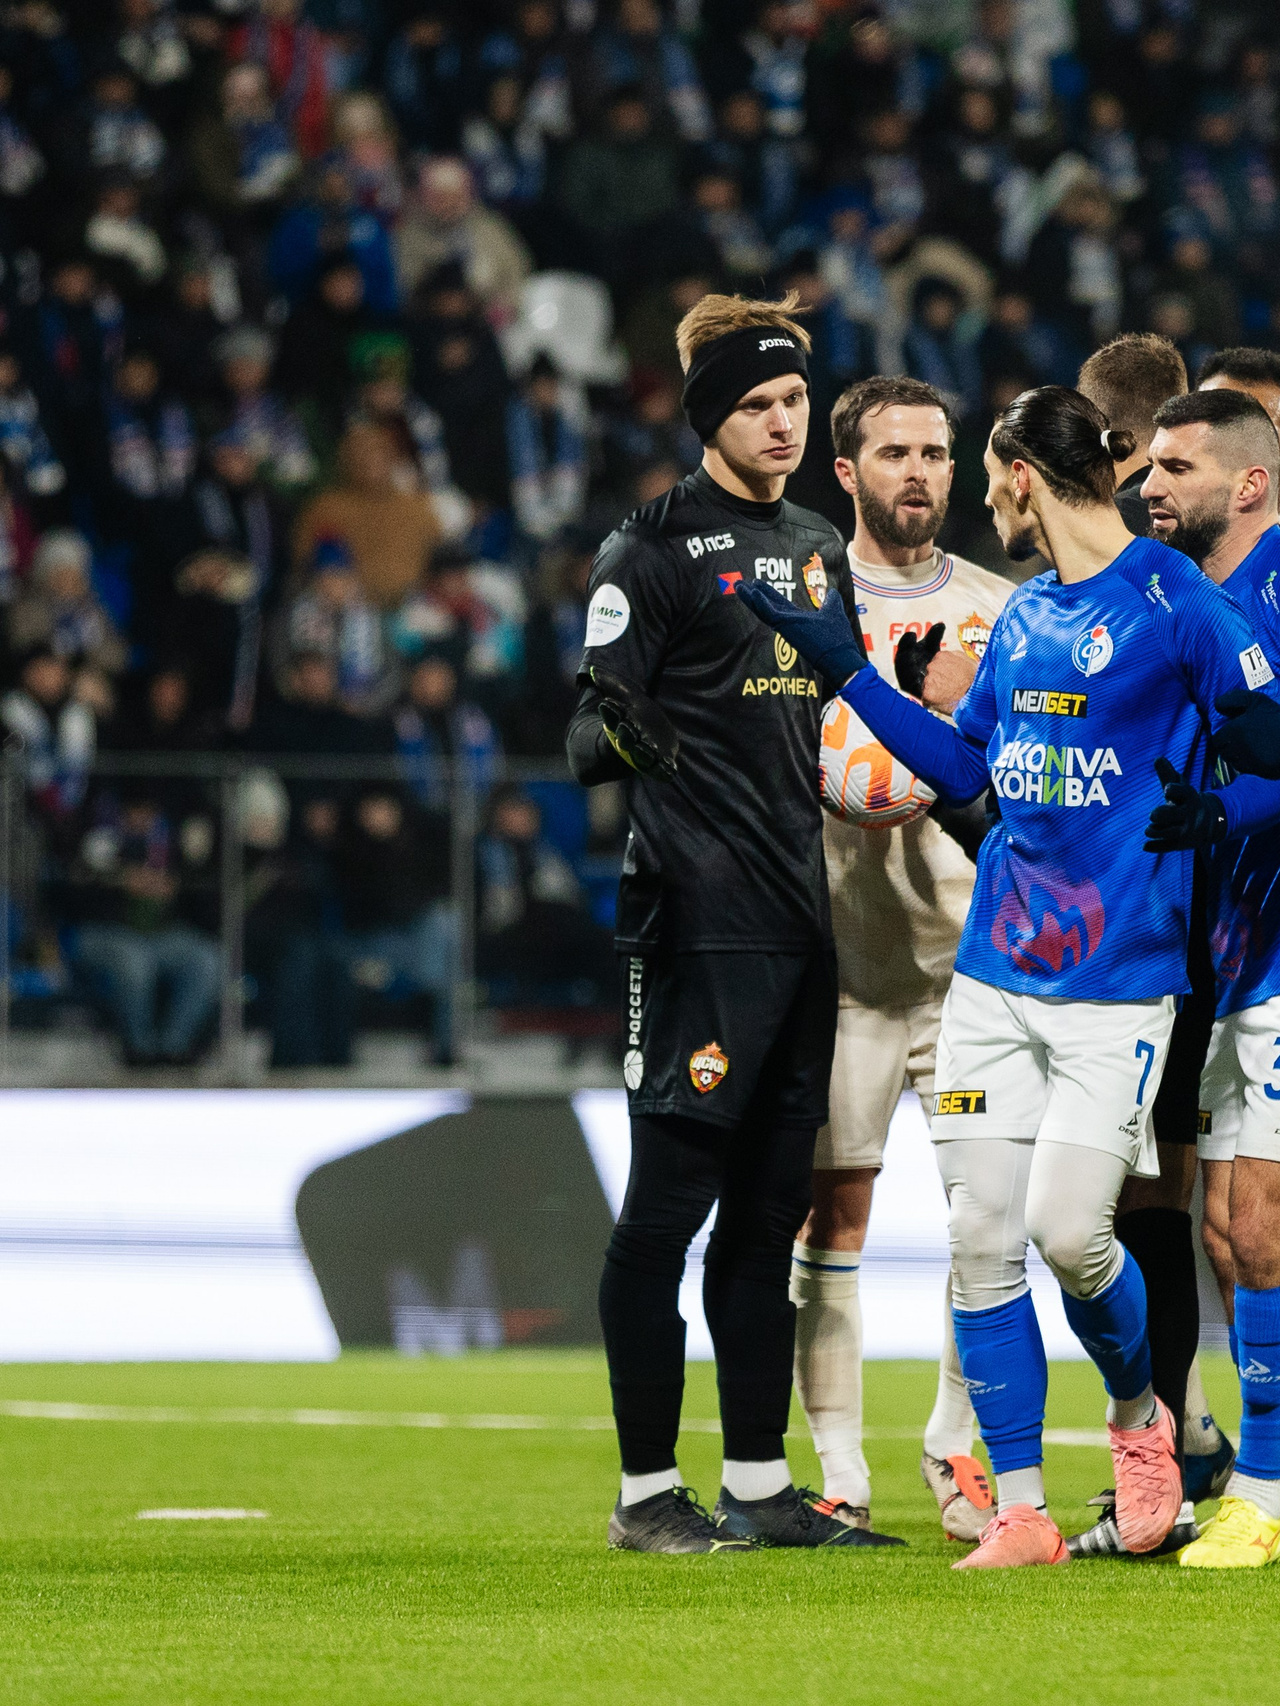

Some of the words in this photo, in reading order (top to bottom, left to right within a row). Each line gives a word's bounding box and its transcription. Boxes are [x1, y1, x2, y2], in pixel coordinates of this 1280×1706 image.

[704, 533, 735, 552] ПСБ
[754, 557, 793, 581] FON
[742, 676, 818, 698] APOTHEA
[1013, 689, 1087, 716] МЕЛБЕТ
[993, 741, 1123, 777] EKONIVA
[992, 767, 1110, 807] КОНИВА
[628, 957, 643, 1046] РОССЕТИ
[691, 1054, 725, 1075] ЦСКА
[1135, 1038, 1156, 1106] 7
[933, 1091, 984, 1115] ЛБЕТ
